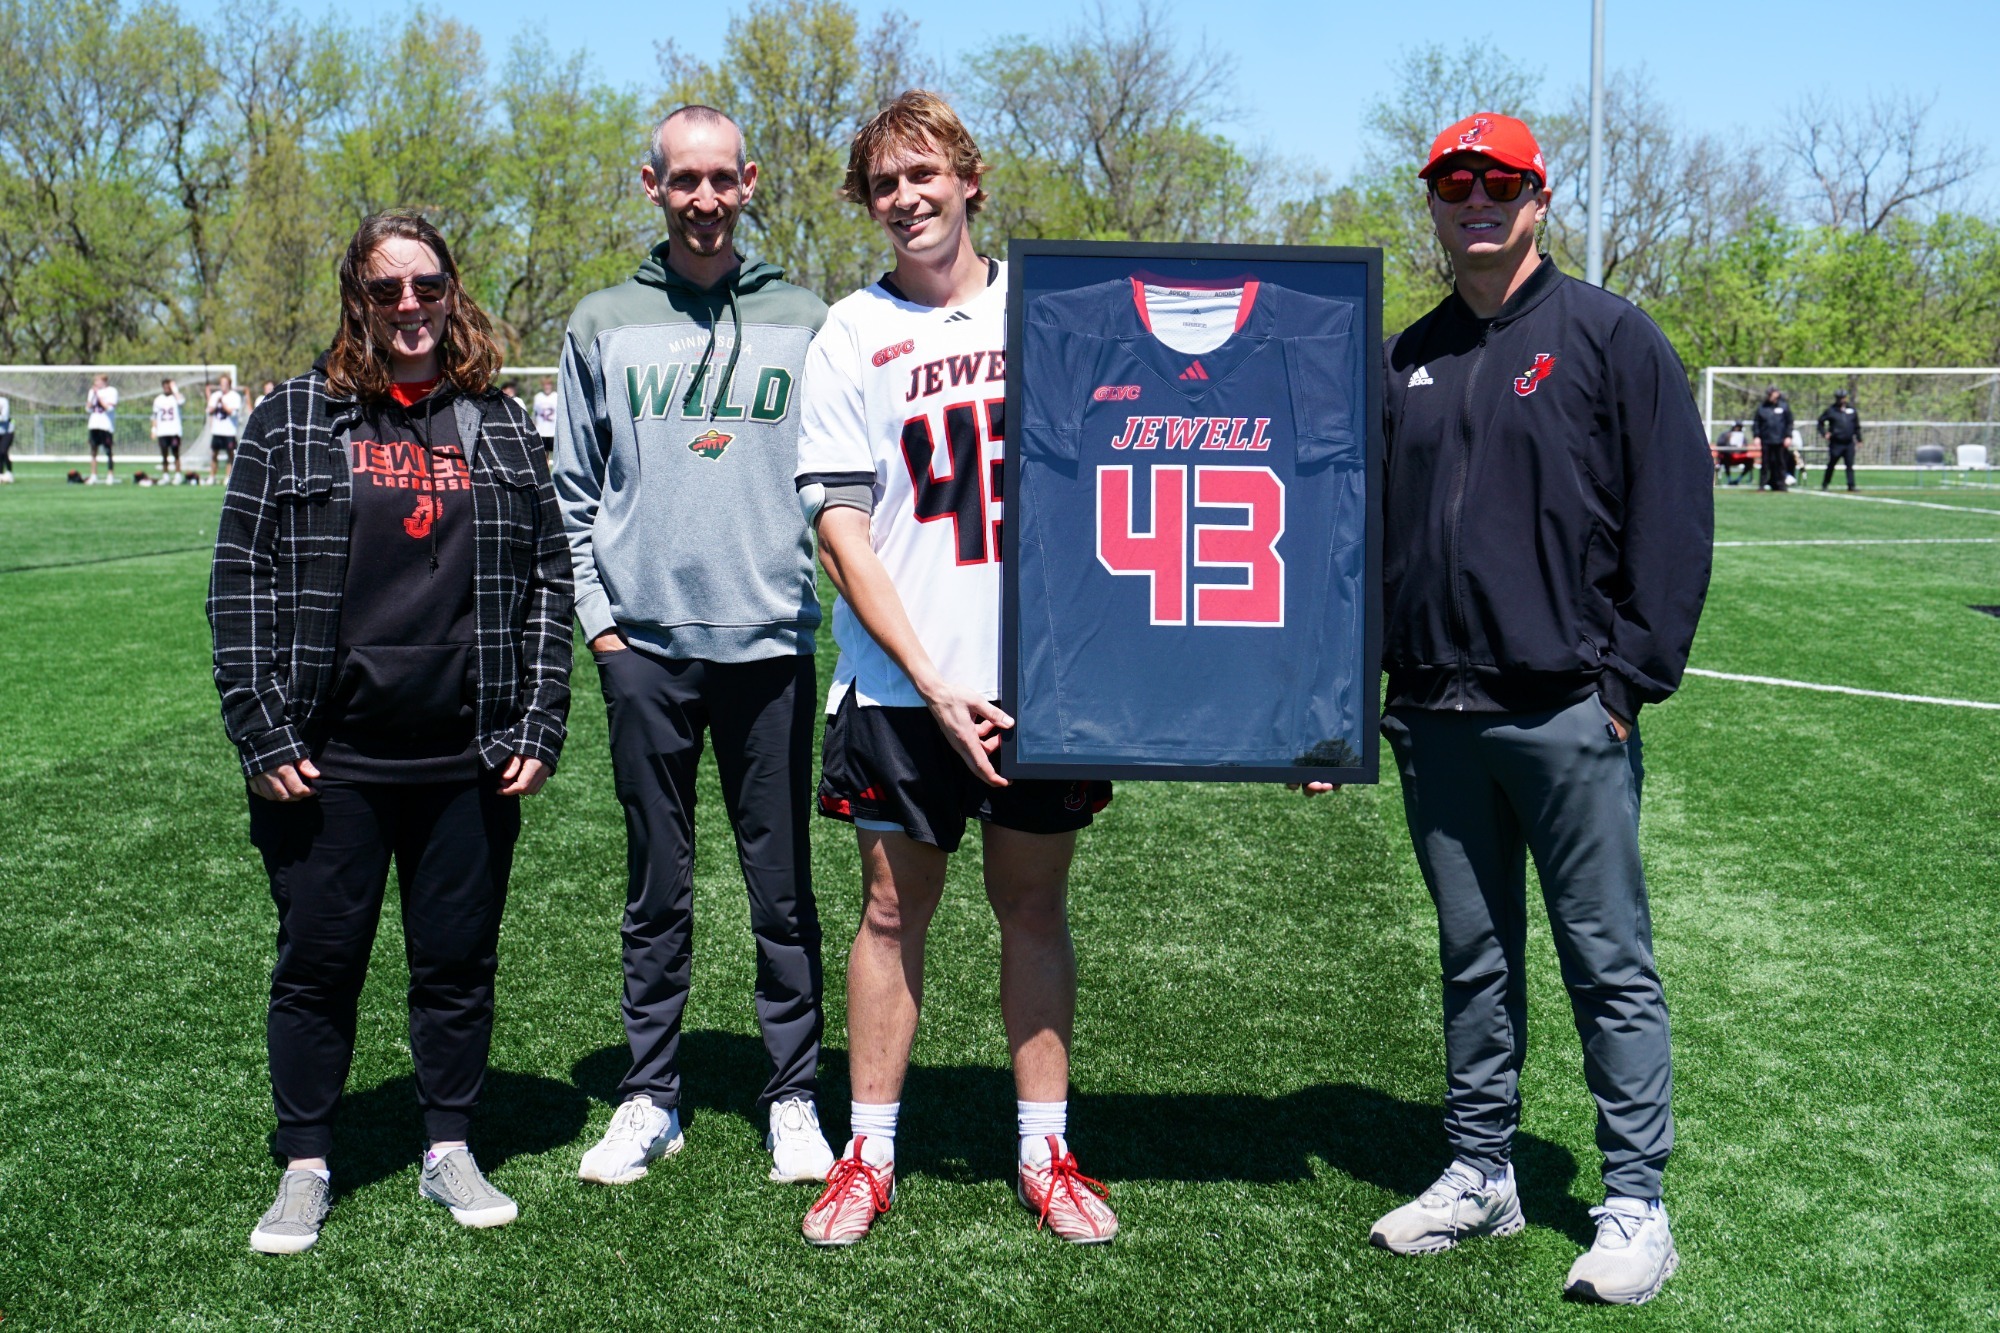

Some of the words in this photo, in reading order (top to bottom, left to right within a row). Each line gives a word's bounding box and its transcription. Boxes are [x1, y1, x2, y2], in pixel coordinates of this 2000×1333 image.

[668, 335, 752, 355] MINNSOA
[872, 339, 915, 367] GLVC
[624, 361, 795, 425] WILD
[1093, 385, 1141, 401] GLVC
[1111, 416, 1272, 451] JEWELL
[372, 475, 470, 490] LACROSSE
[900, 397, 1005, 566] 4
[1096, 464, 1285, 627] 43
